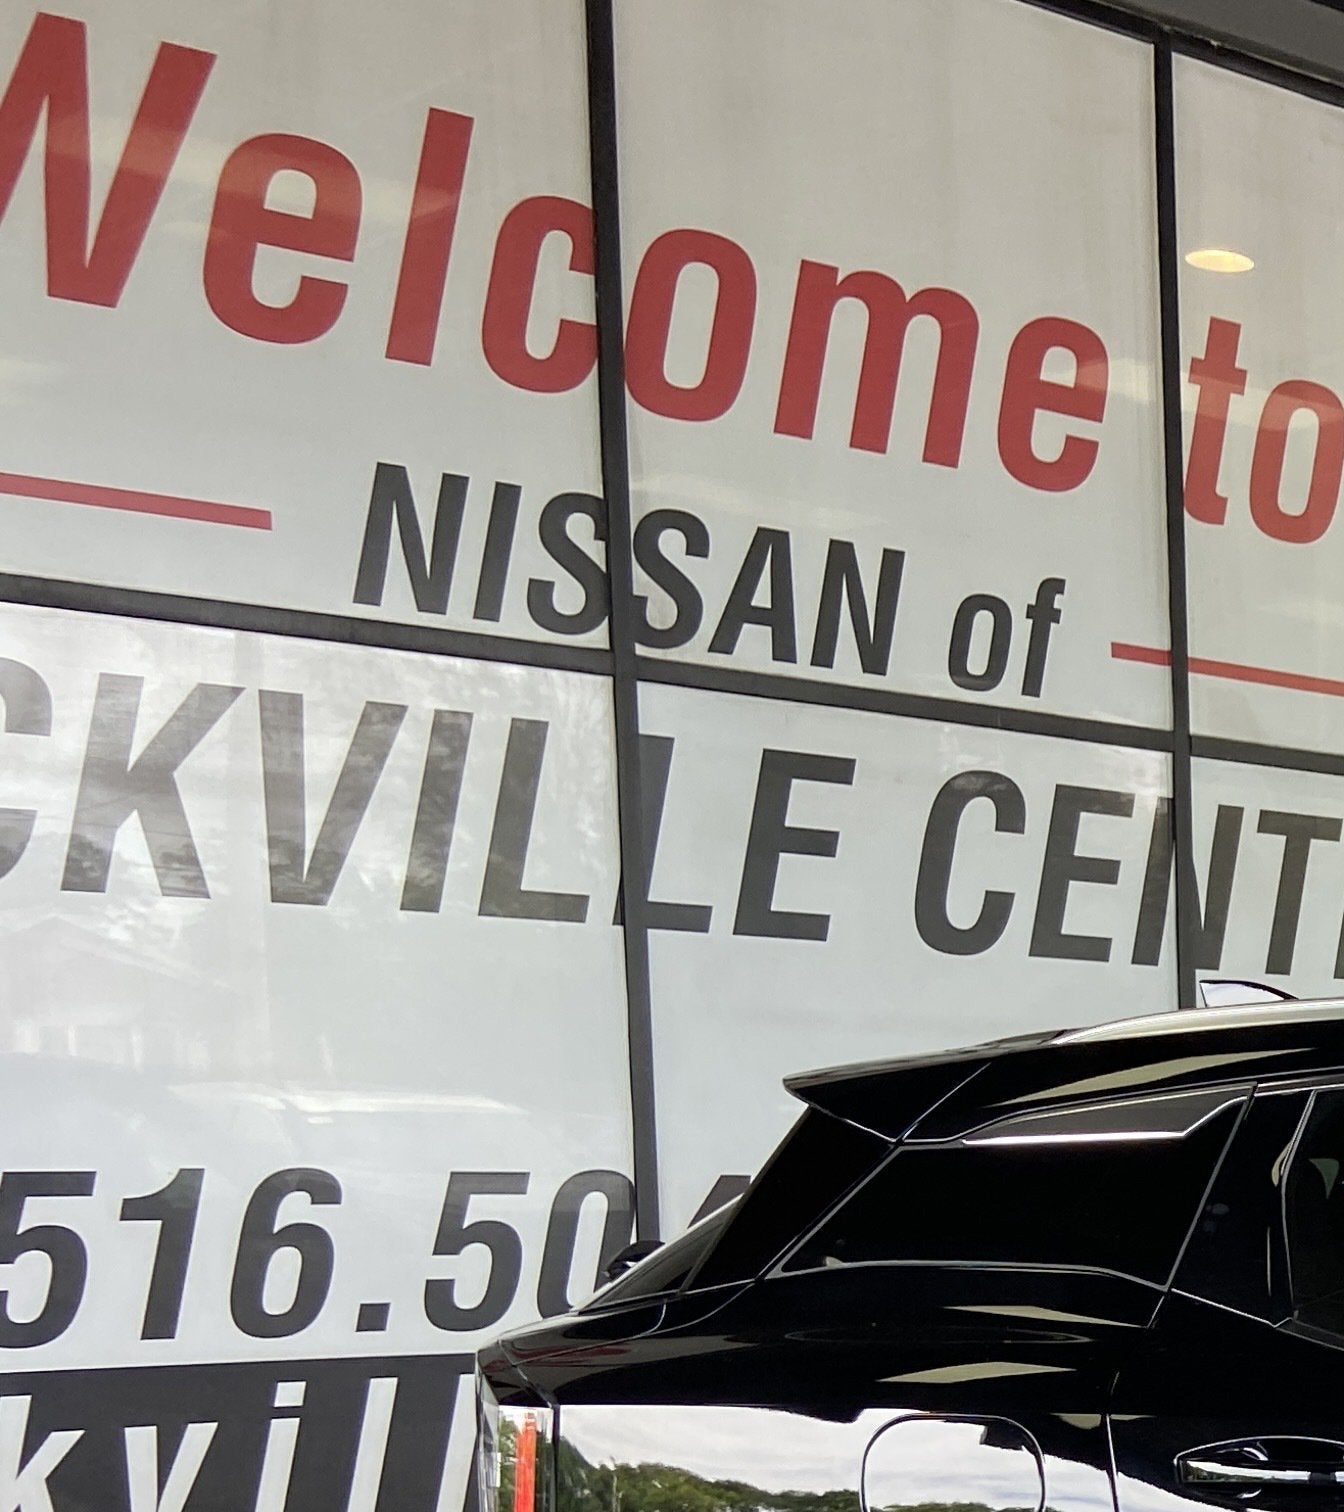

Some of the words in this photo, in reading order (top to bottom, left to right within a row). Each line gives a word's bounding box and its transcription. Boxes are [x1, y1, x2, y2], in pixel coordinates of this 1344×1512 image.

[0, 11, 1110, 492] Welcome
[352, 461, 906, 677] NISSAN
[946, 577, 1067, 698] of
[0, 1166, 752, 1349] 516.50
